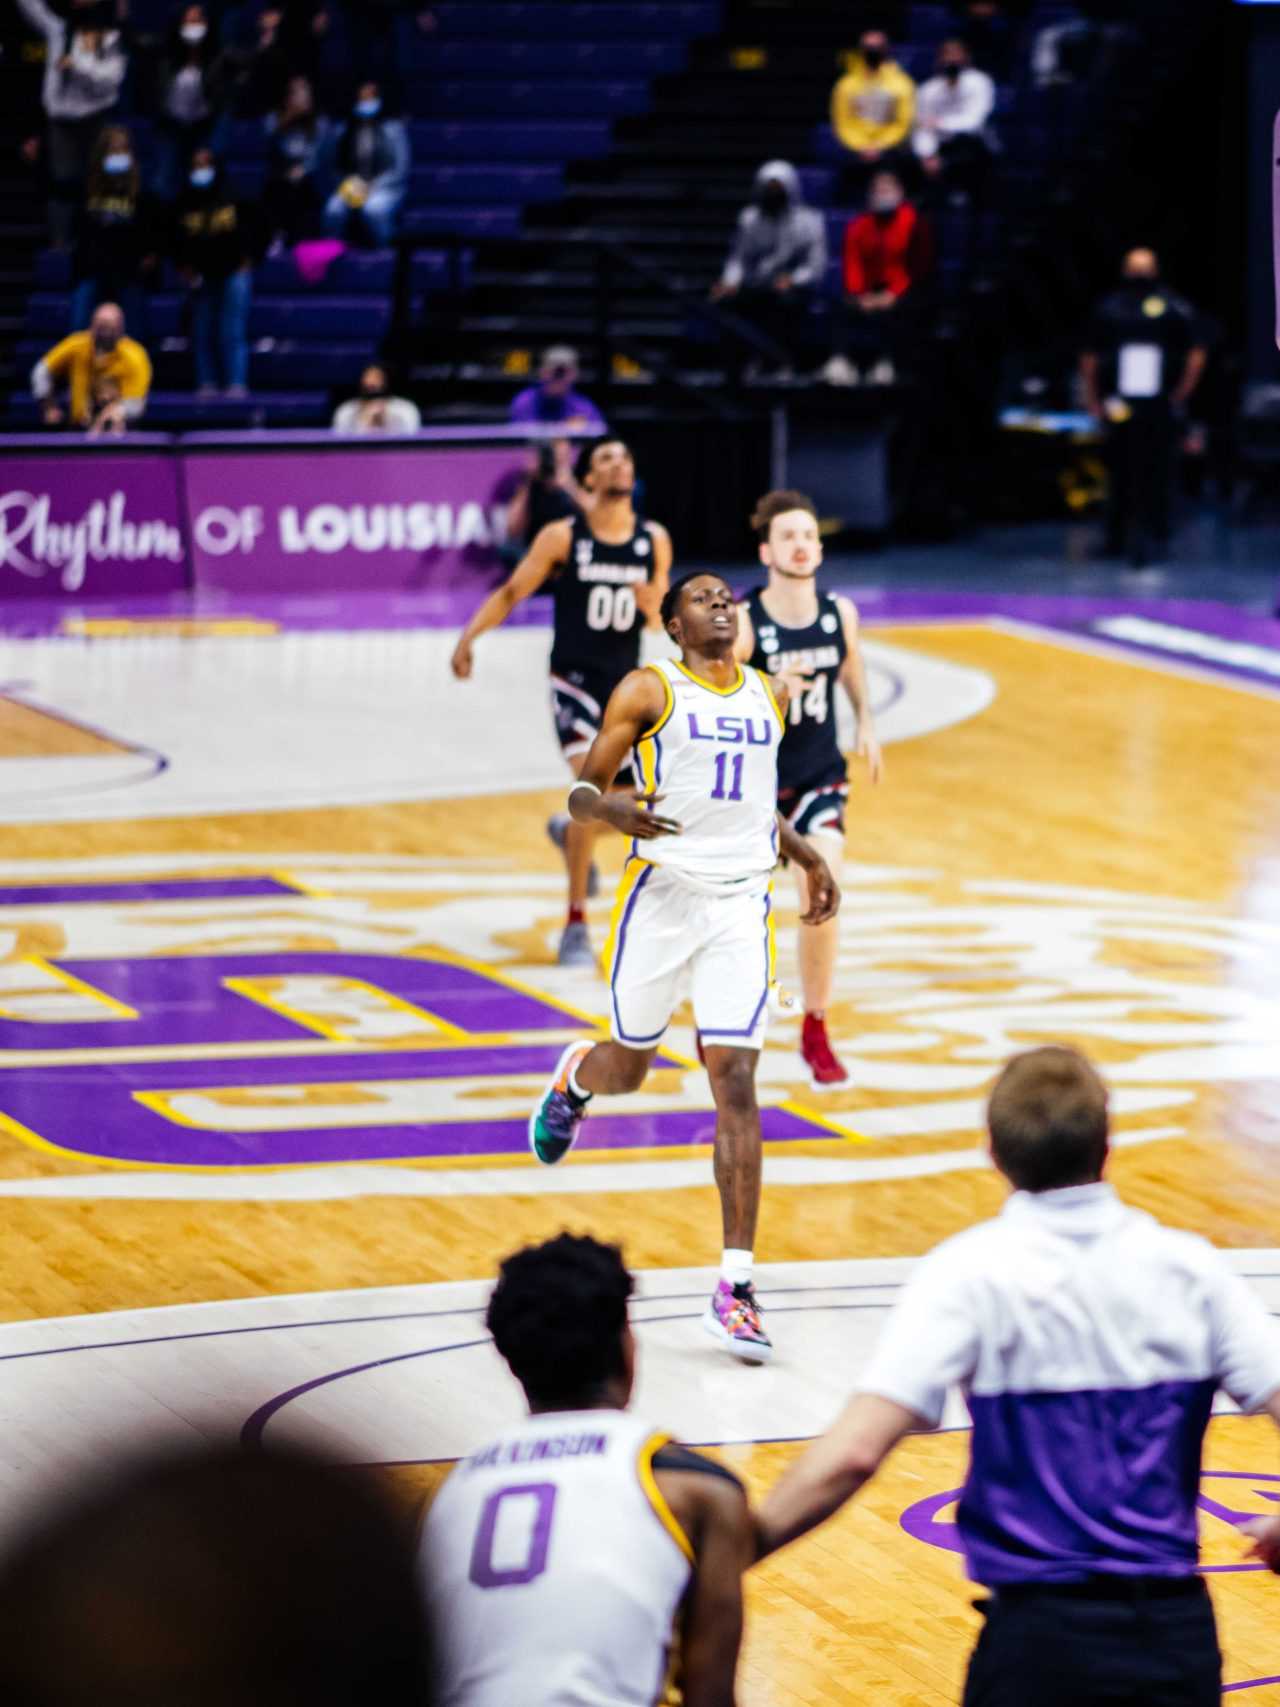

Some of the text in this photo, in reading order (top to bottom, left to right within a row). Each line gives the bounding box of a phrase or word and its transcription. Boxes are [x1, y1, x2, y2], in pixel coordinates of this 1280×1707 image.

[0, 491, 184, 591] Rhythm
[196, 506, 263, 556] OF
[587, 586, 636, 632] 00
[688, 712, 772, 747] LSU
[710, 751, 745, 802] 11
[469, 1482, 558, 1590] 0
